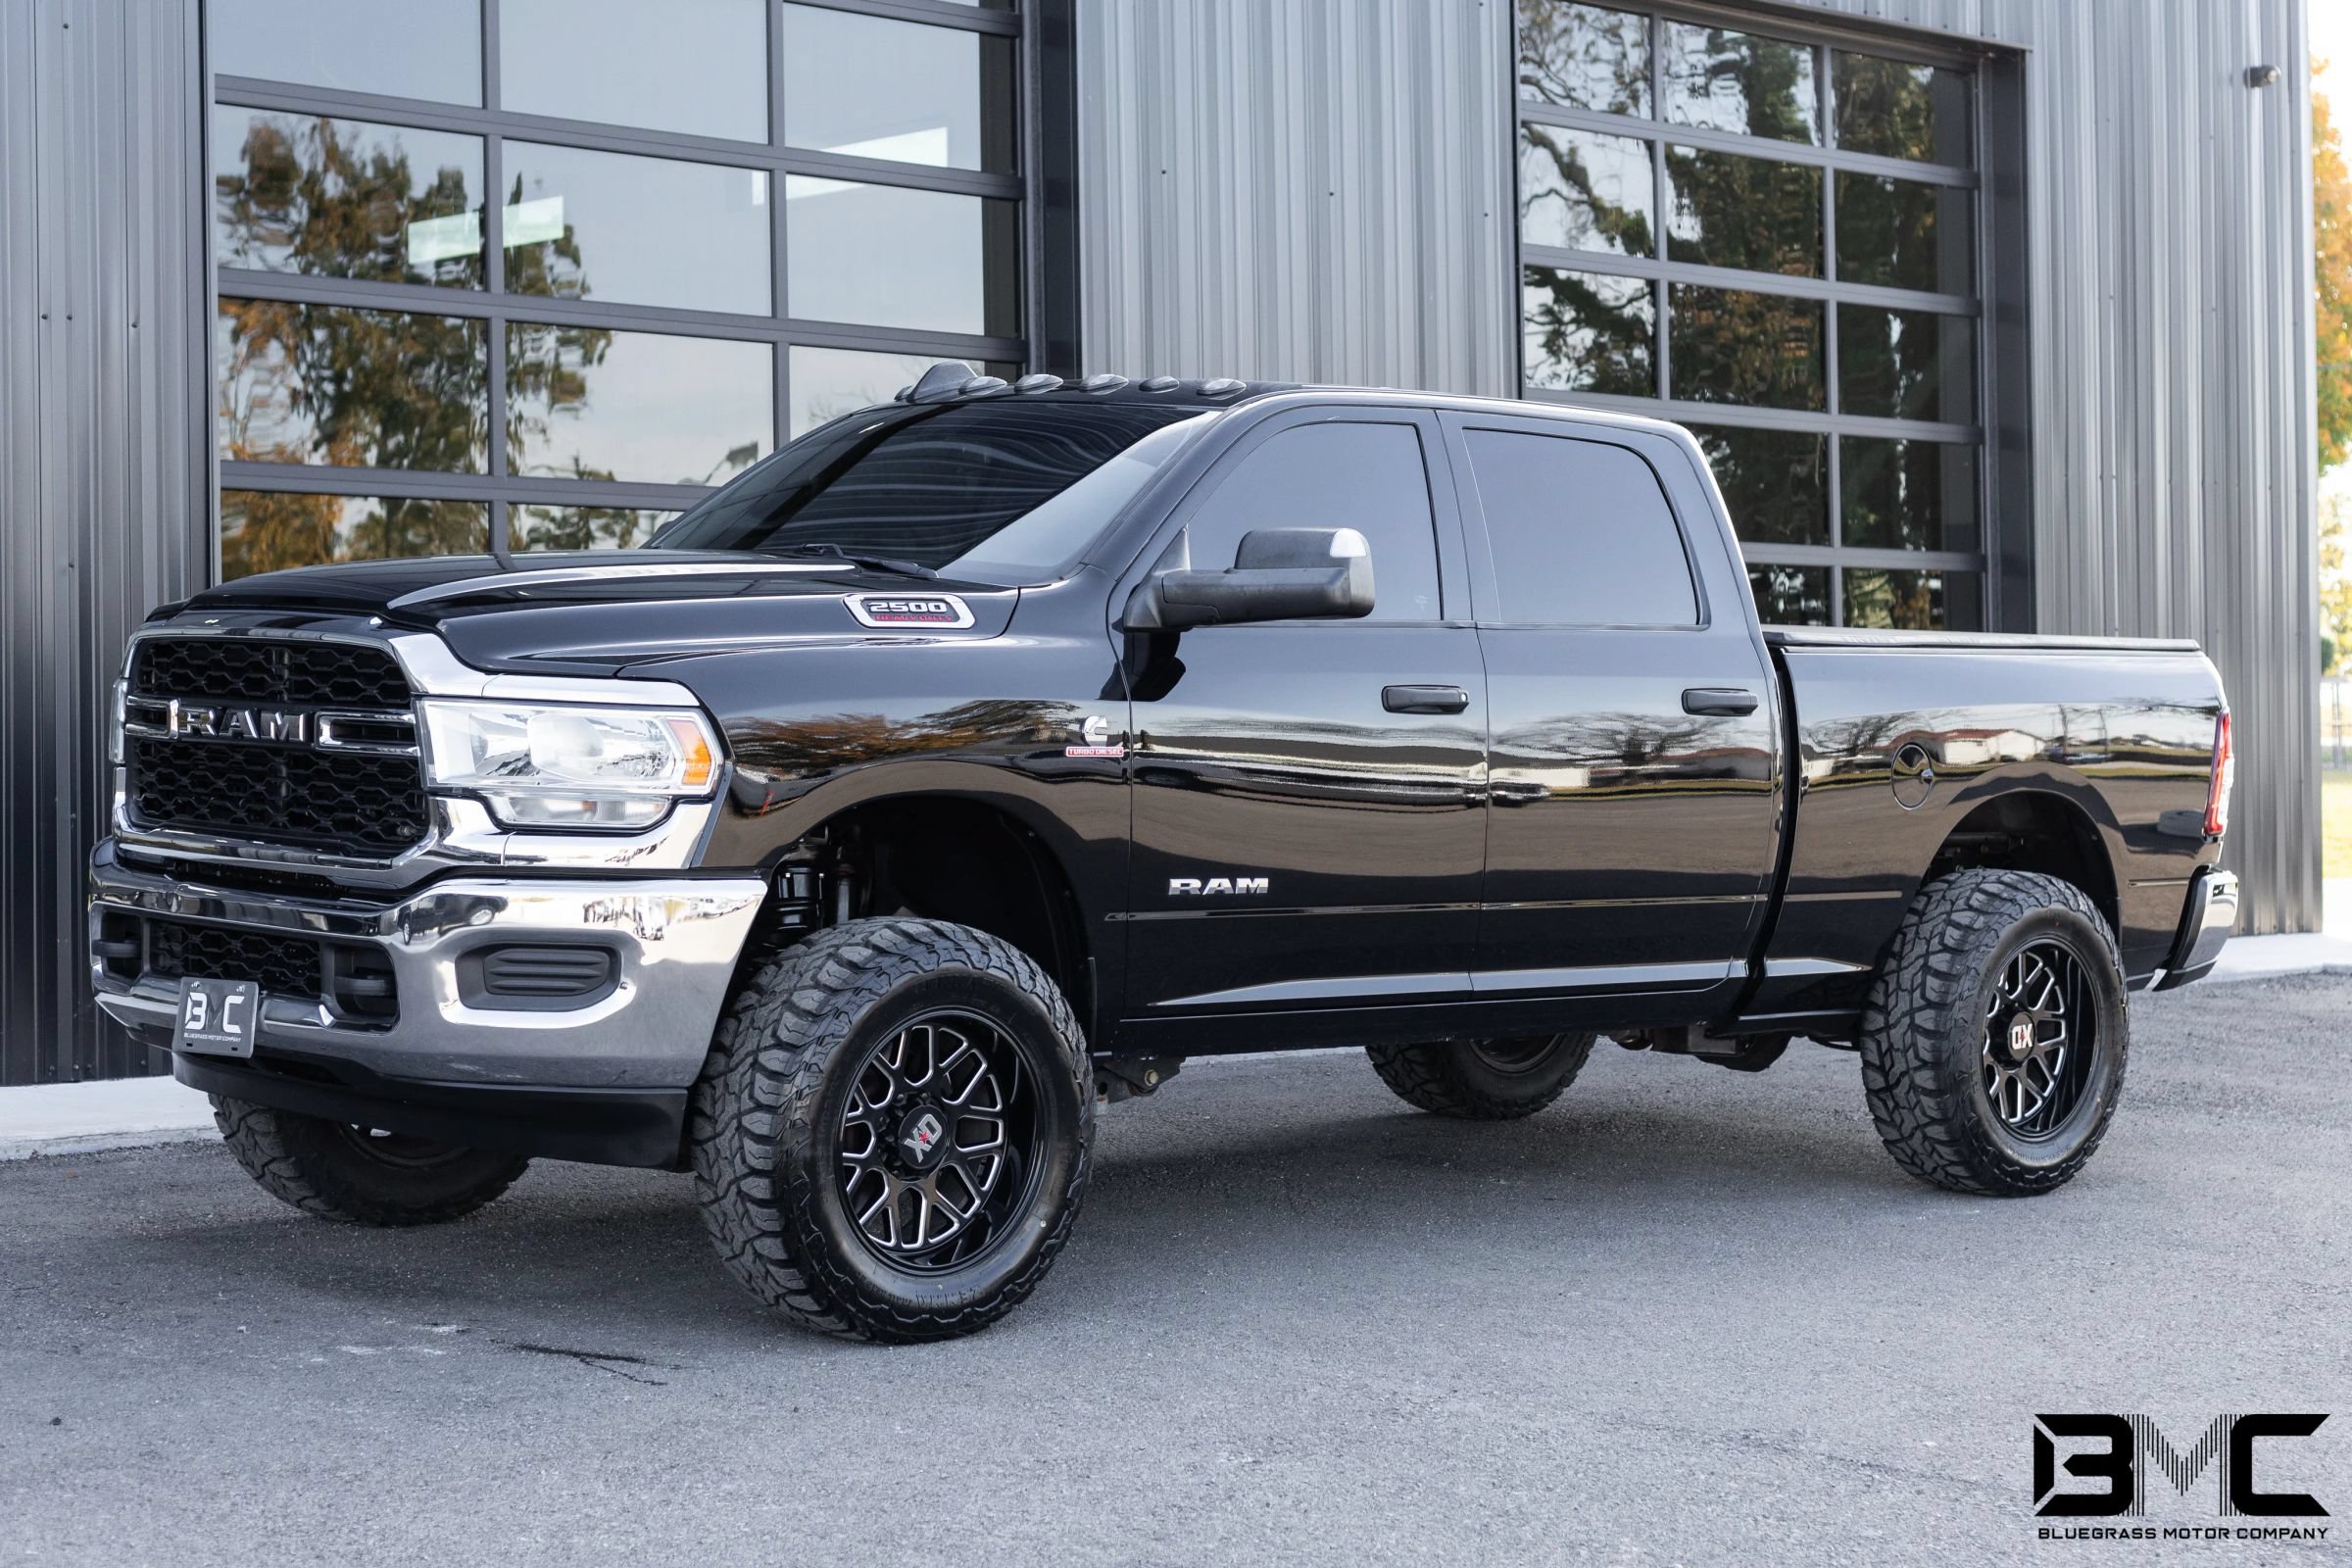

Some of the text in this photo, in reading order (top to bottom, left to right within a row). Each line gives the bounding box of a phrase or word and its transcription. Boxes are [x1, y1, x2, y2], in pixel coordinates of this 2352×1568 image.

[868, 602, 948, 612] 2500
[178, 706, 305, 742] RAM
[1168, 877, 1269, 896] RAM
[904, 1113, 943, 1163] XD
